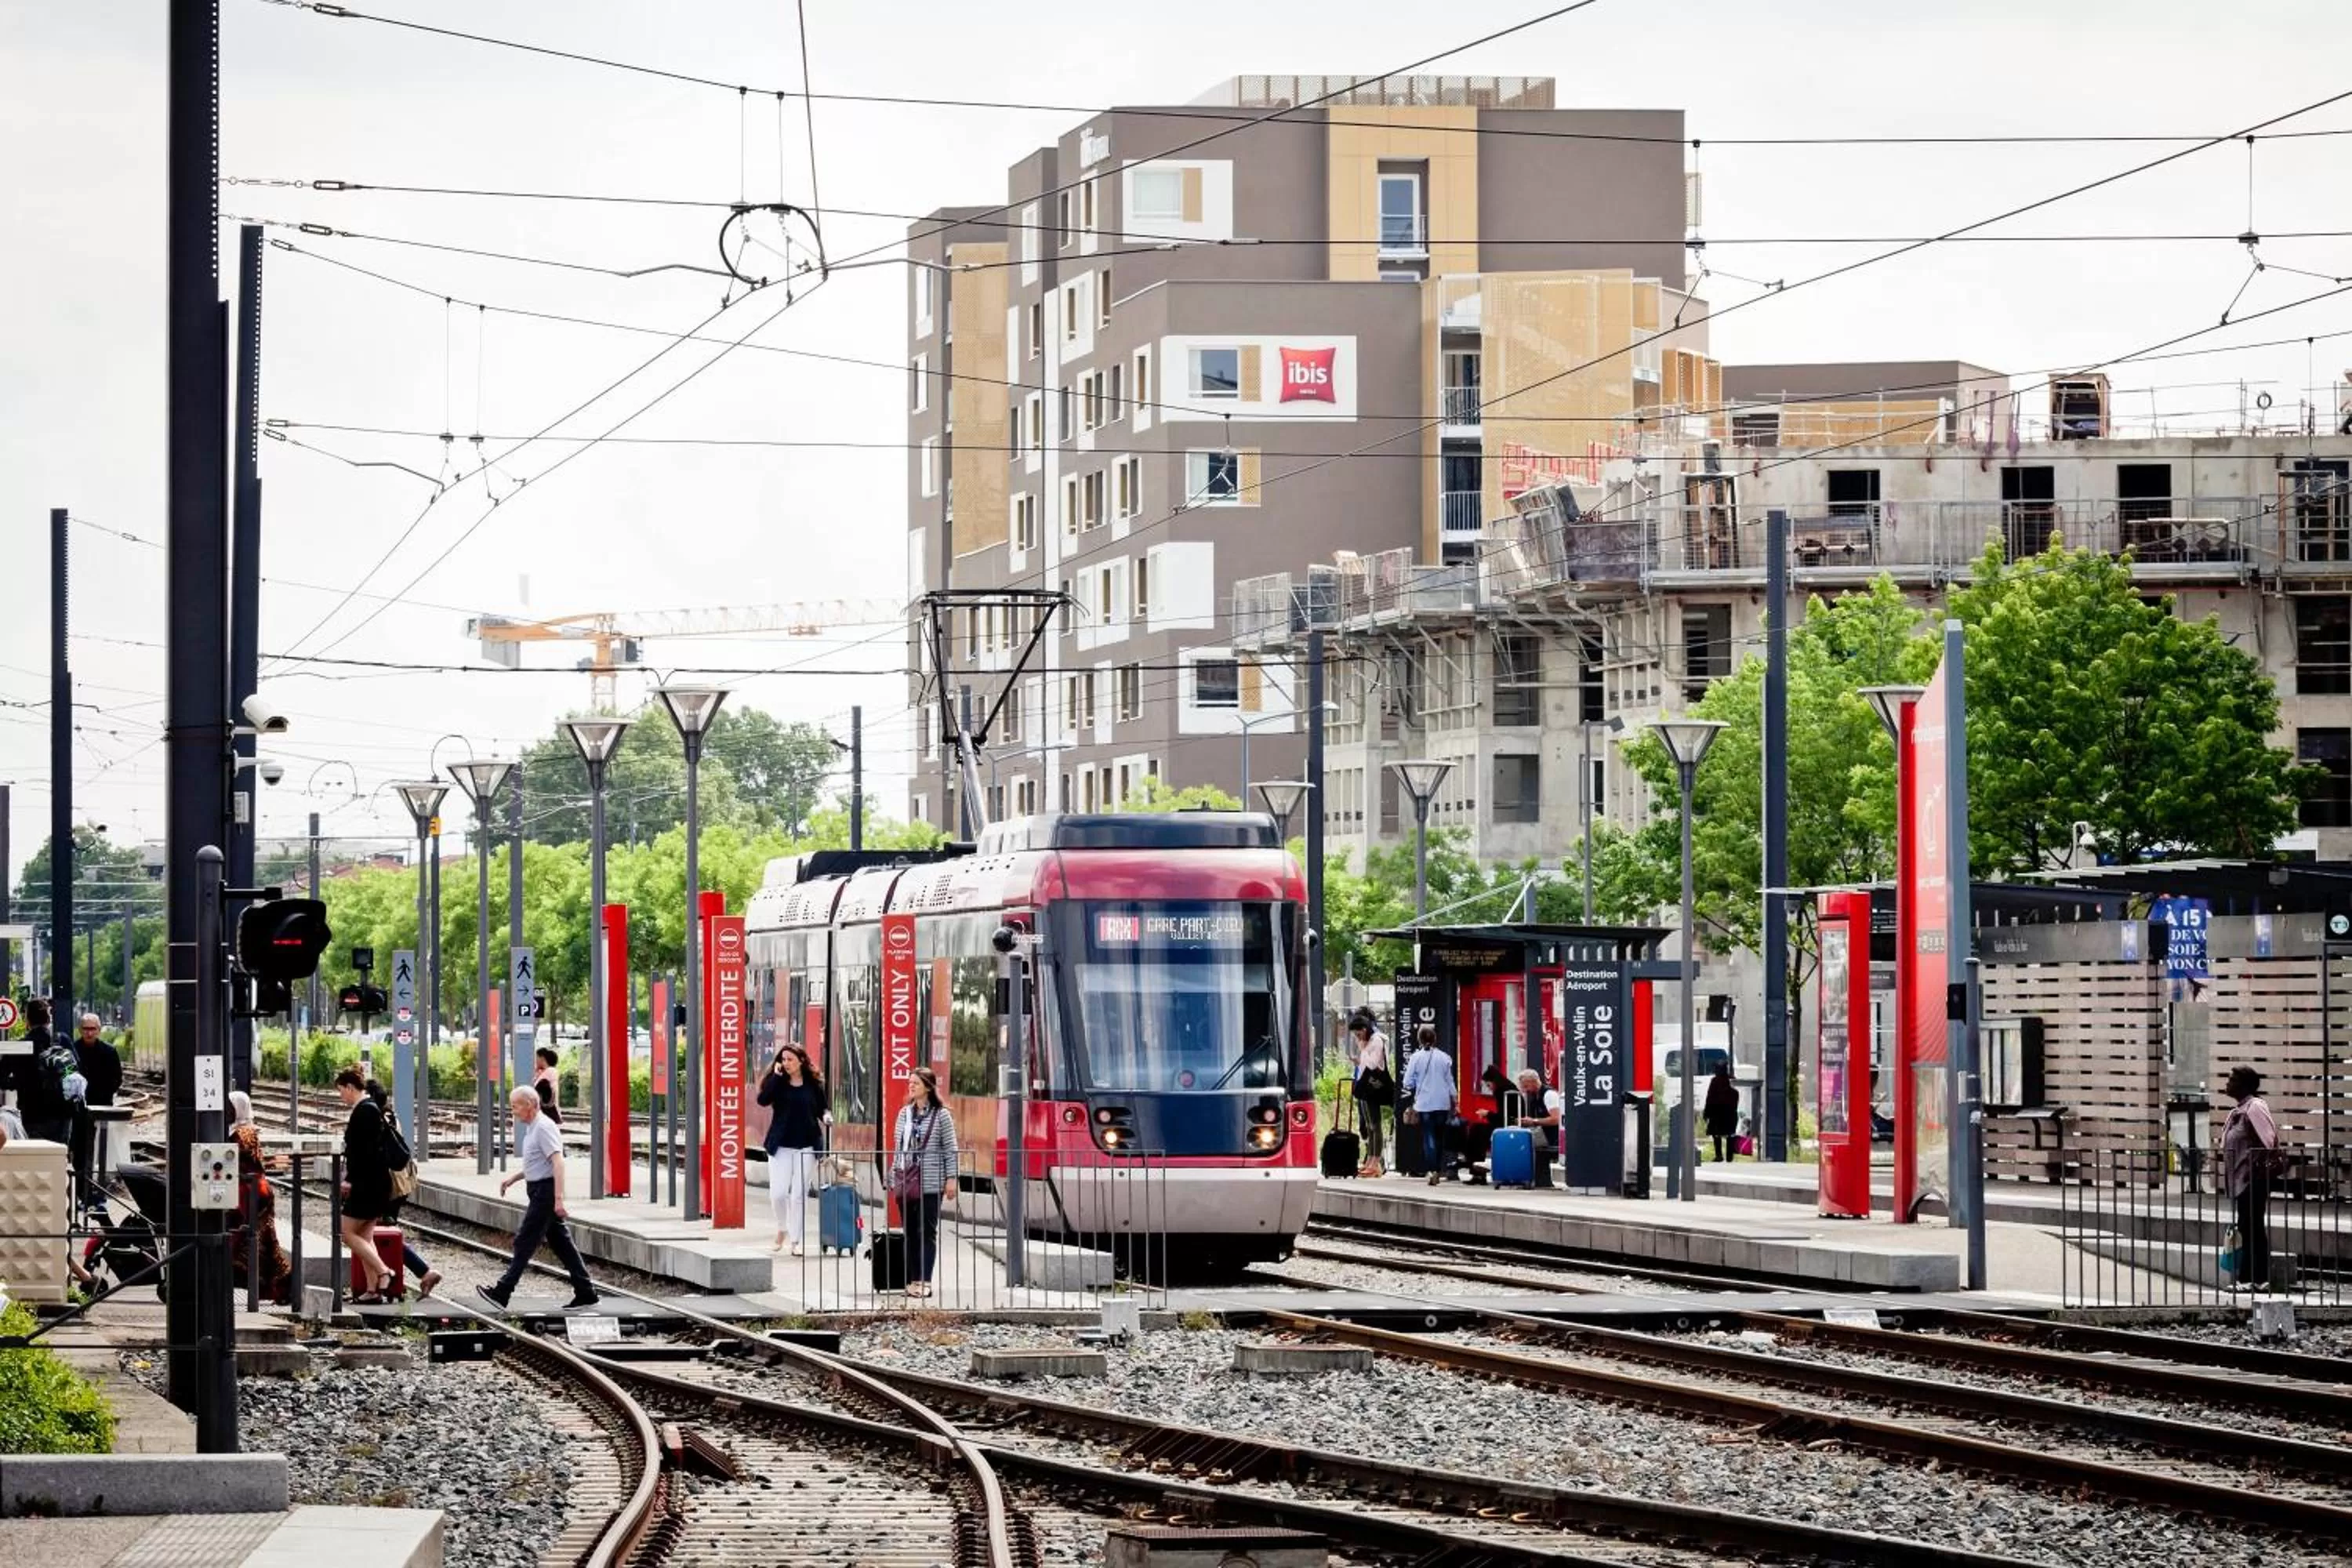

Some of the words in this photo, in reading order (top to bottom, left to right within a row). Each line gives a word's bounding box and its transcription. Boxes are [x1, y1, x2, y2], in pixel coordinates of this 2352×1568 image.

[1288, 361, 1328, 384] ibis
[2183, 909, 2201, 927] 15
[2171, 929, 2192, 941] DE
[1566, 970, 1618, 978] Destination
[1396, 985, 1429, 994] Aéroport
[1566, 981, 1608, 992] Aéroport
[891, 969, 910, 1028] ONLY
[521, 1006, 529, 1015] P
[720, 970, 739, 1079] INTERDITE
[1588, 1005, 1613, 1065] Soie
[891, 1033, 910, 1080] EXIT
[1573, 1006, 1587, 1106] Vaulx-en-Velin
[203, 1087, 216, 1098] 34
[1588, 1074, 1613, 1105] La
[717, 1085, 739, 1178] MONTÉE
